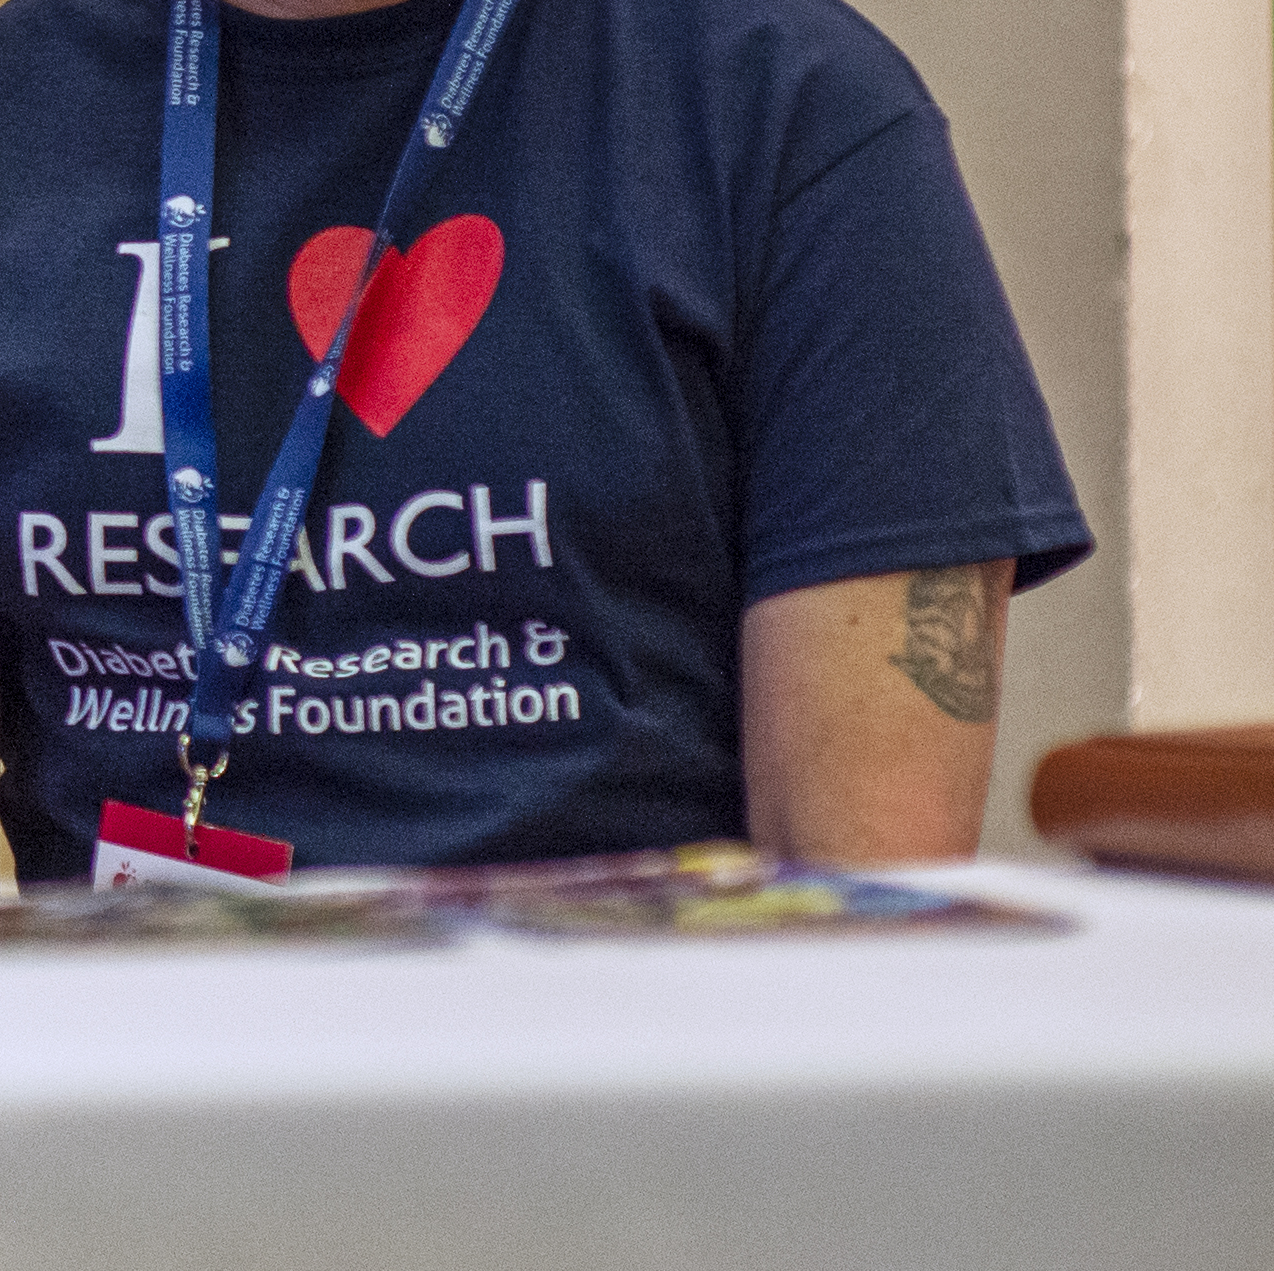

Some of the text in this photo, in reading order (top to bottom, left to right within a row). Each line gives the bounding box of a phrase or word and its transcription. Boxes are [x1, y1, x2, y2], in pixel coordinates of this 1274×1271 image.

[171, 29, 188, 106] Foundation
[188, 29, 203, 91] Research
[441, 52, 472, 109] Diabetes
[452, 60, 485, 116] Wellness
[186, 94, 200, 106] &
[163, 233, 177, 374] Wellness Foundation
[178, 233, 193, 371] Diabetes Research &
[178, 509, 195, 569] Wellness
[193, 509, 209, 571] Diabetes
[235, 487, 290, 626] Diabetes Research &
[250, 489, 305, 630] Wellness Foundation
[49, 619, 569, 680] Diabet Research &
[65, 676, 581, 735] Wellns Foundation
